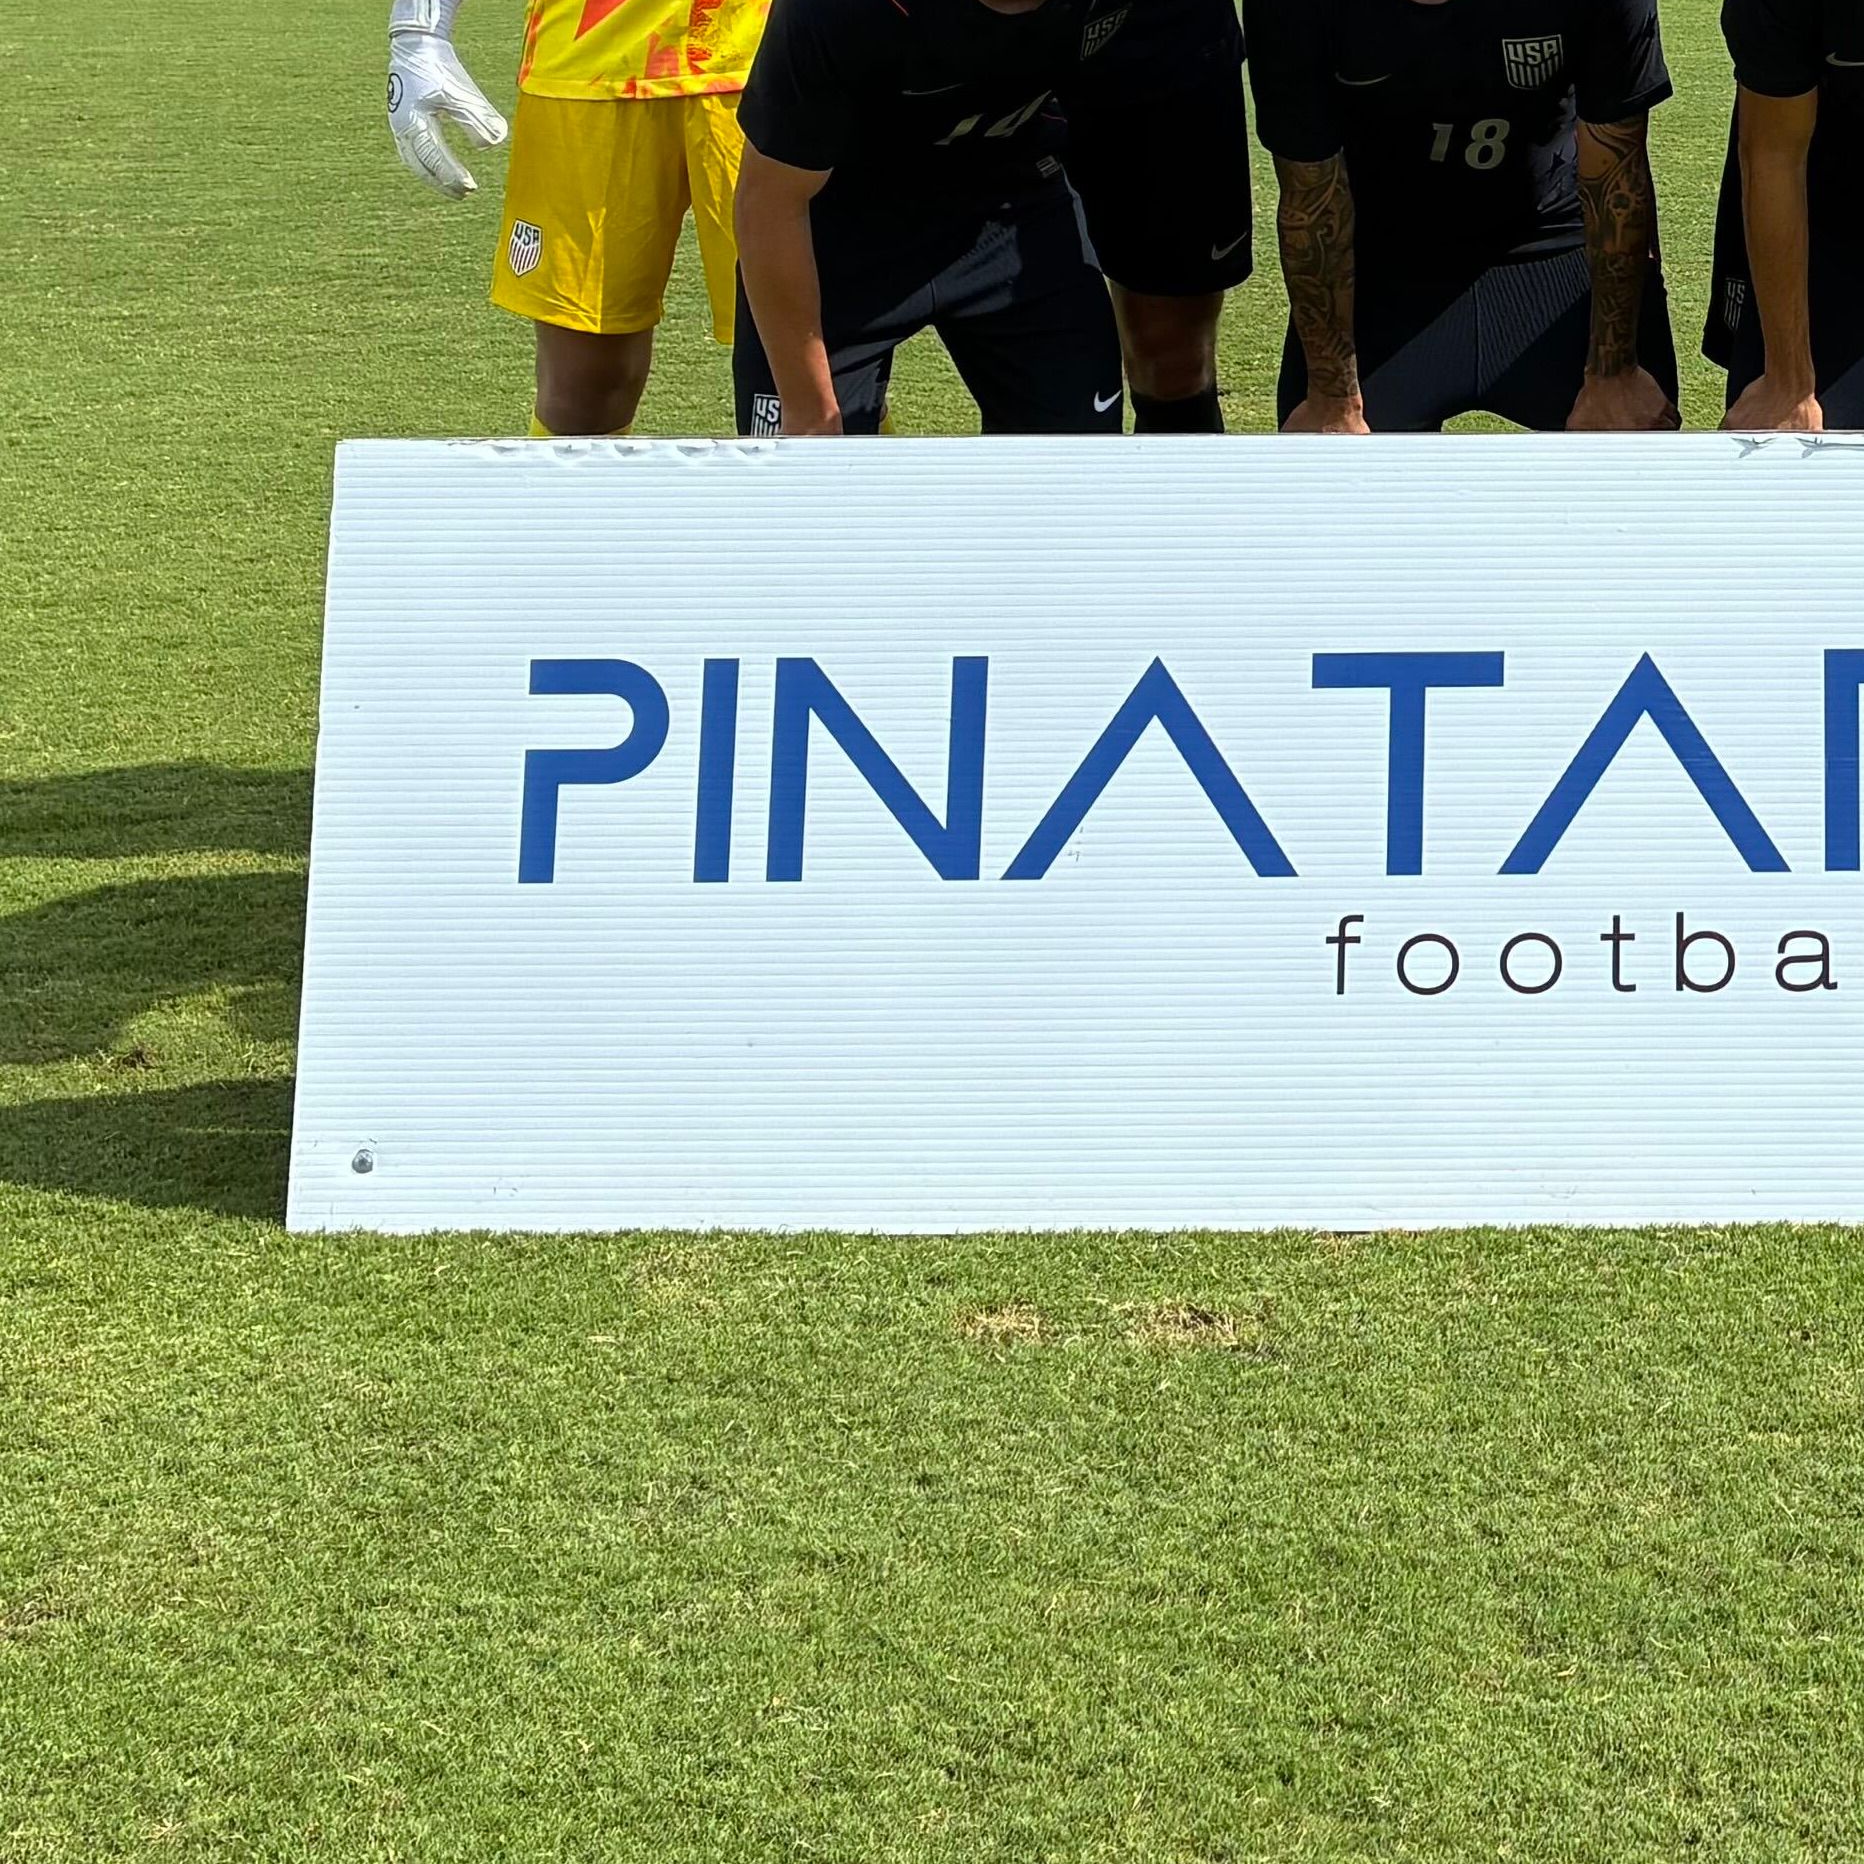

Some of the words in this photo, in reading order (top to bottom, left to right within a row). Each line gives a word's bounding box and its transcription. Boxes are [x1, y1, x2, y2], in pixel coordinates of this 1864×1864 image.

[1508, 39, 1558, 65] USA
[1429, 118, 1511, 171] 18
[515, 222, 540, 247] USA
[756, 397, 781, 423] US
